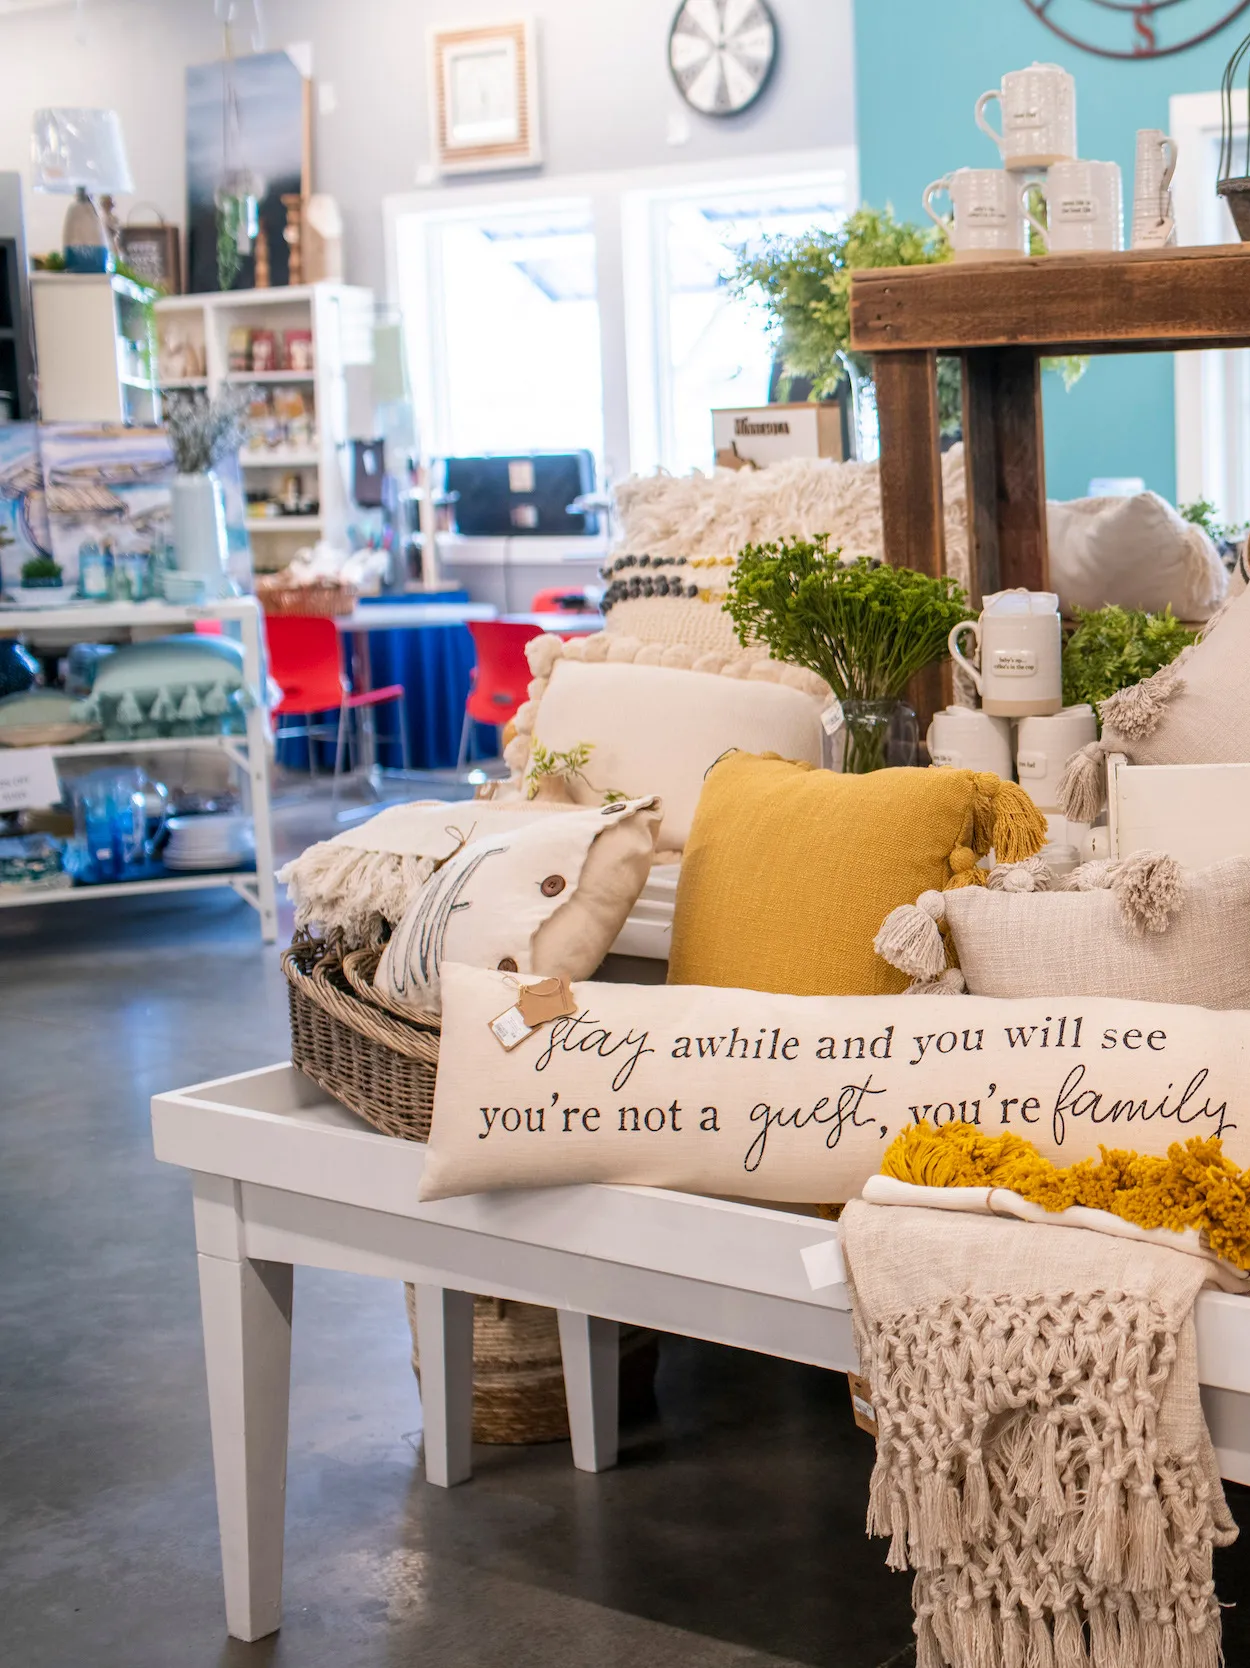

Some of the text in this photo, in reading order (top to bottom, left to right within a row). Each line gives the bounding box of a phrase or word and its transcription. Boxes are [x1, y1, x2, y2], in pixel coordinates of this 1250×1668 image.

[536, 1009, 655, 1091] stay
[671, 1026, 800, 1061] awhile
[815, 1025, 895, 1060] and
[909, 1031, 984, 1066] you
[1003, 1016, 1083, 1049] will
[1101, 1028, 1167, 1051] see
[478, 1064, 1237, 1173] you're not a guest, you're family
